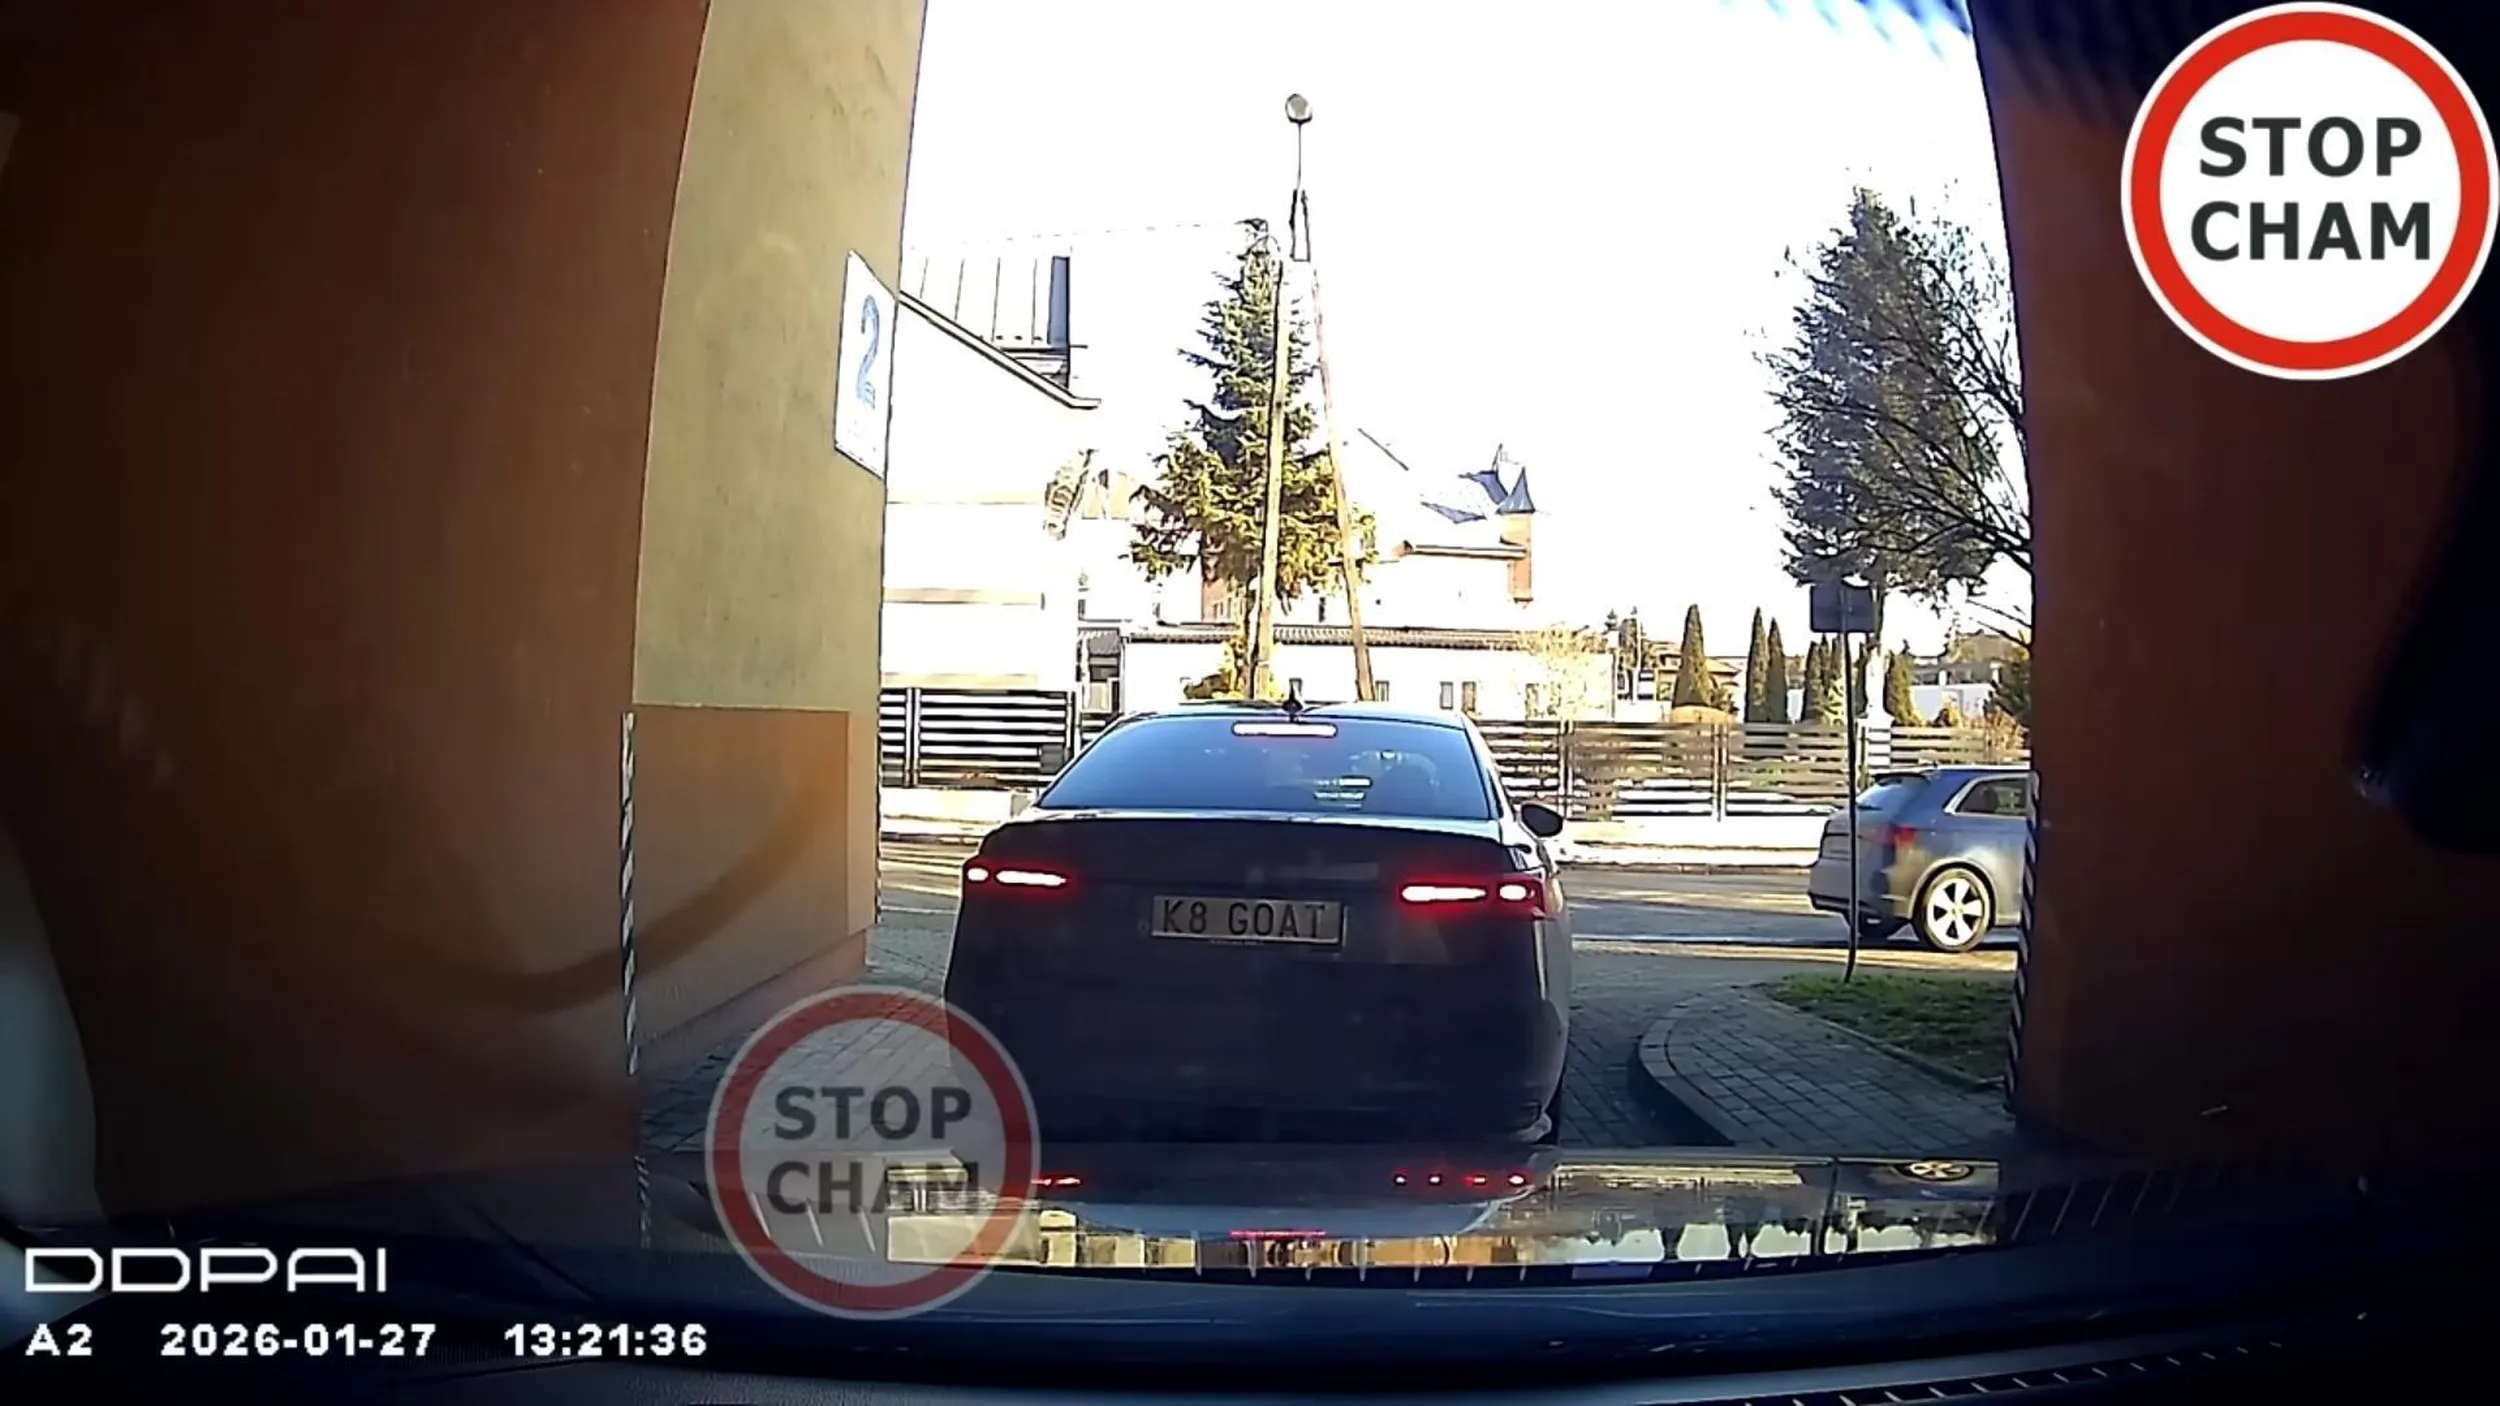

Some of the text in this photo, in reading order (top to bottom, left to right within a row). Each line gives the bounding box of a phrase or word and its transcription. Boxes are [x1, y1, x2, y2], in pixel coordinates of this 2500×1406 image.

[856, 294, 880, 410] 2
[1163, 899, 1326, 938] K8 GOAT
